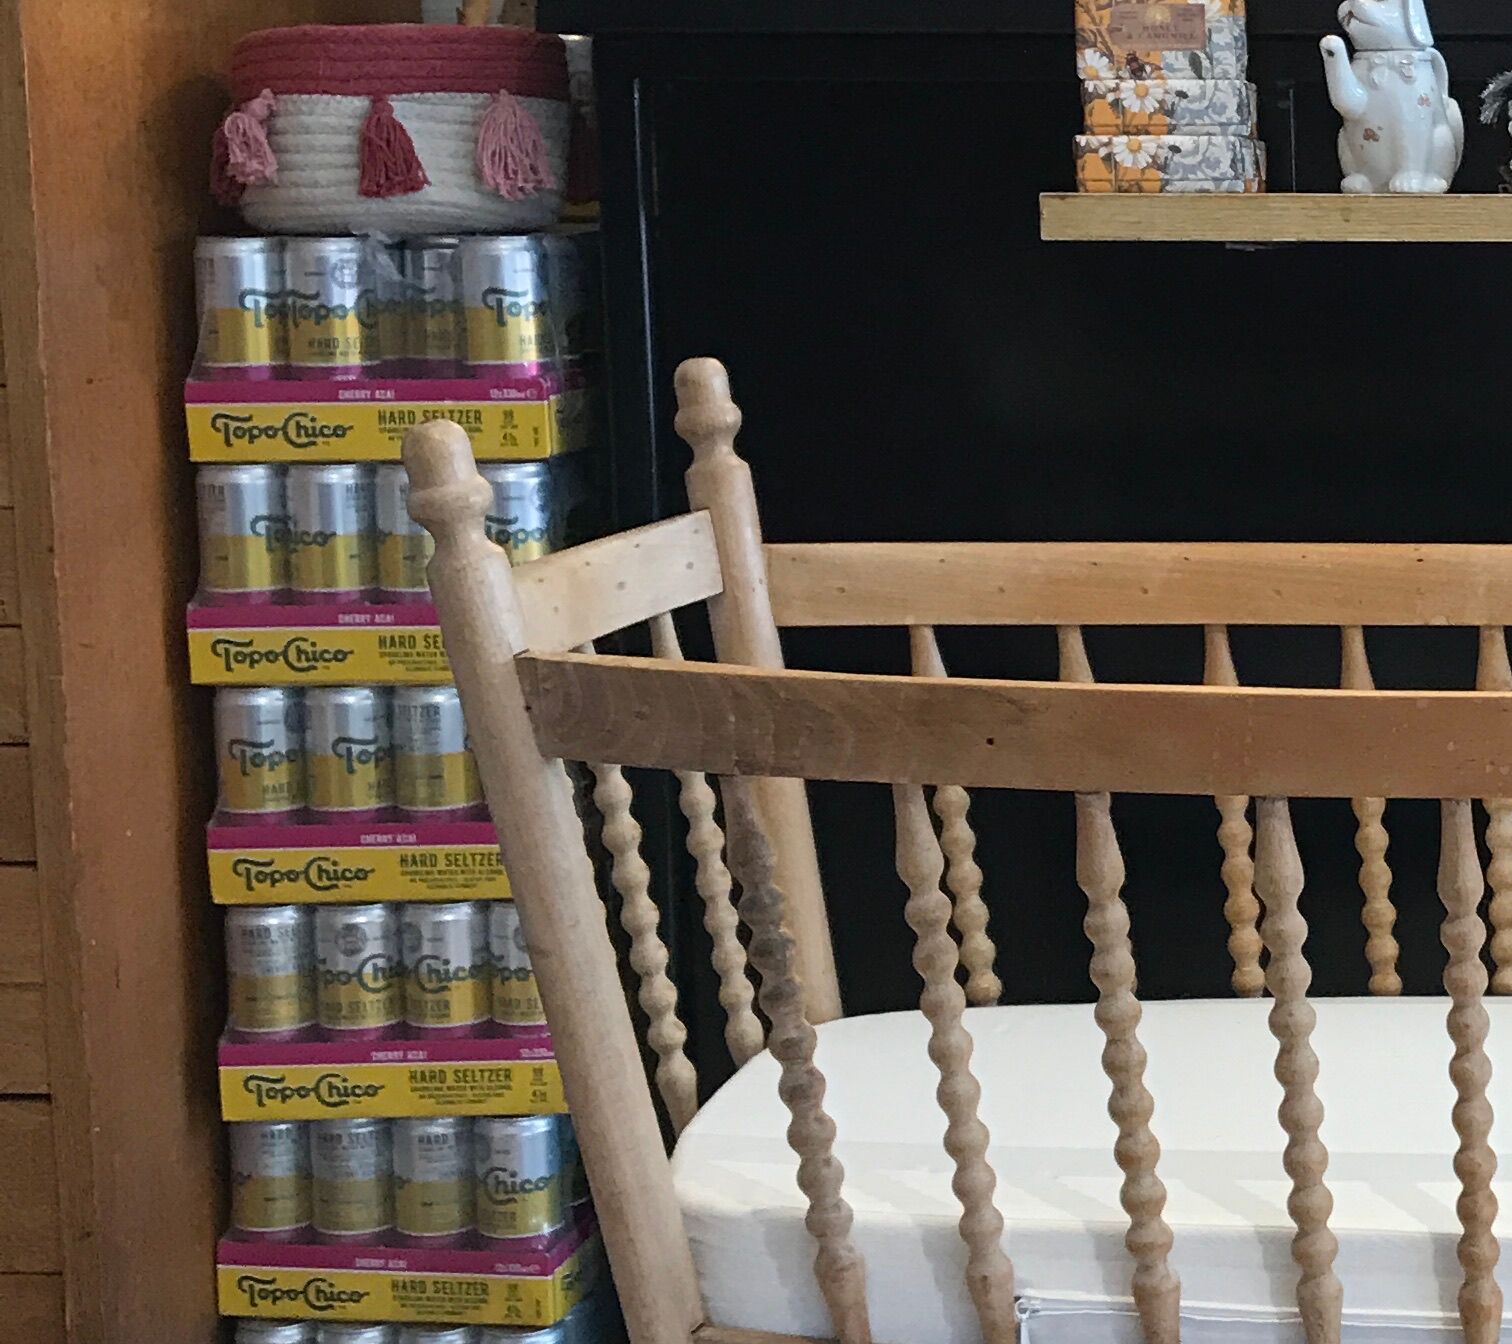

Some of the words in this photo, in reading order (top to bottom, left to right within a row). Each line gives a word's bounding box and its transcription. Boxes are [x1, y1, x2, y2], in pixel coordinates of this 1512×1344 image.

[210, 412, 283, 447] Topo
[282, 411, 354, 449] Chico
[378, 409, 416, 426] HARD
[210, 636, 283, 673] Topo
[282, 635, 354, 673] Chico
[378, 634, 417, 650] HARD
[400, 853, 438, 868] HARD
[232, 857, 305, 893] Topo
[304, 856, 375, 892] Chico
[408, 1069, 448, 1085] HARD
[453, 1068, 513, 1084] SELTZER
[243, 1073, 315, 1108] Topo
[314, 1072, 385, 1107] Chico
[237, 1274, 305, 1309] Topo
[304, 1276, 370, 1312] Chico
[391, 1279, 427, 1295] HARD
[432, 1280, 490, 1296] SELTZER
